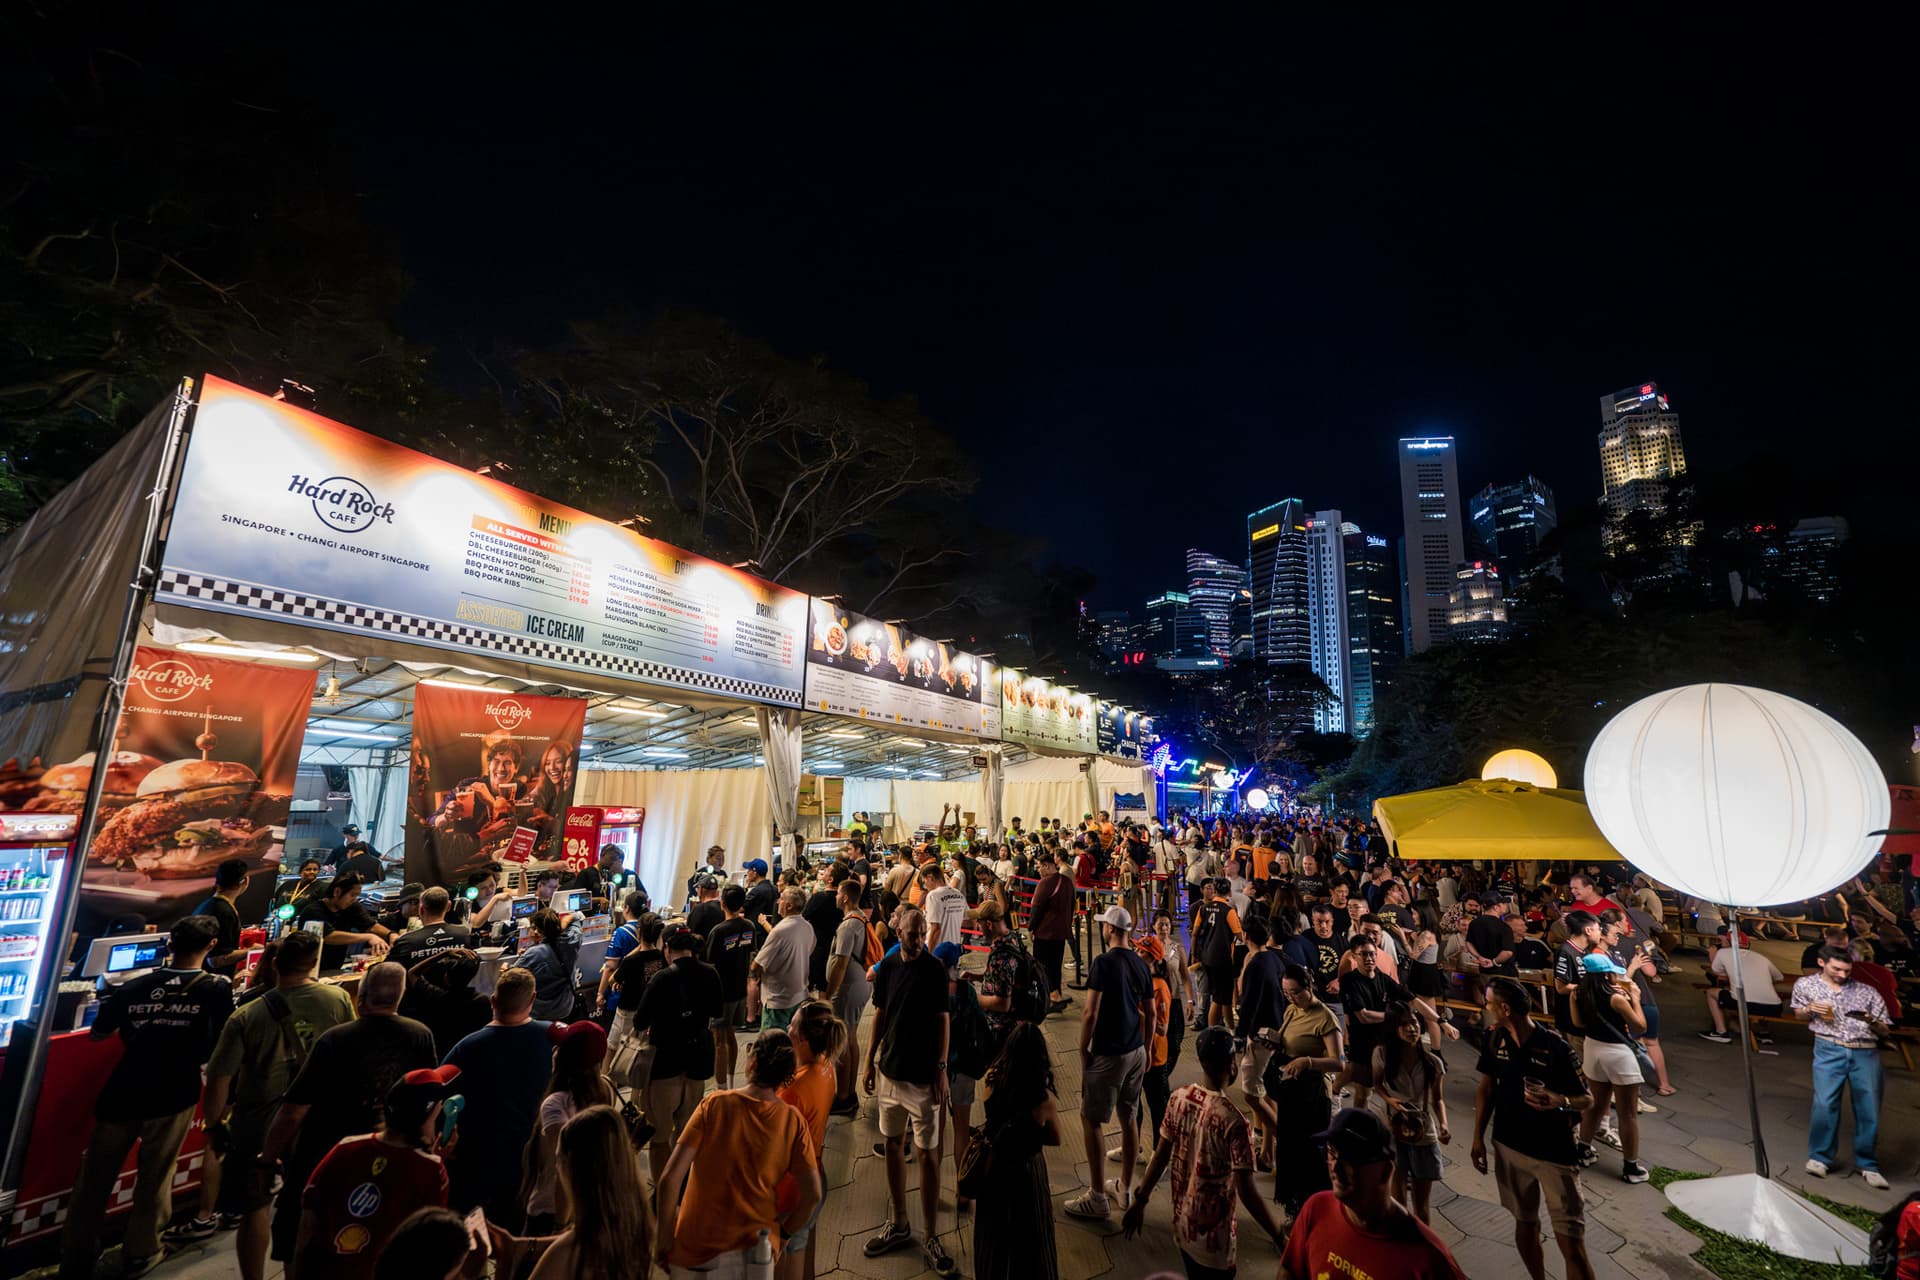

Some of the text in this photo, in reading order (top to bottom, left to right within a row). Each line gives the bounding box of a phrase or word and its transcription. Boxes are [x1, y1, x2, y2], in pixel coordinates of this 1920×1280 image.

[1640, 393, 1655, 401] UOB
[288, 475, 395, 524] Hard Rock
[330, 511, 357, 524] CAFE
[221, 514, 430, 572] SINGAPORE CHANGI AIRPORT SINGAPORE
[487, 523, 504, 534] ALL
[506, 529, 538, 544] SERVED
[470, 532, 527, 553] CHEESEBURGER
[528, 549, 550, 560] (200g)
[467, 550, 502, 564] CHICKEN
[502, 560, 519, 568] HOT
[520, 564, 536, 574] DOG
[468, 540, 484, 550] DBL
[484, 545, 540, 566] CHEESEBURGER
[542, 561, 562, 573] (400g)
[464, 568, 480, 578] BBQ
[482, 572, 503, 584] PORK
[504, 579, 520, 588] RIBS
[465, 558, 481, 568] BBQ
[483, 563, 504, 574] PORK
[505, 569, 545, 585] SANDWICH
[645, 573, 658, 581] BULL
[608, 574, 637, 586] HEINEKEN
[638, 581, 656, 592] DRAFT
[608, 582, 640, 595] HOUSEPOUR
[640, 591, 661, 601] LIQUORS
[606, 597, 622, 606] LONG
[622, 601, 643, 612] ISLAND
[644, 606, 656, 616] ICED
[657, 610, 667, 618] TEA
[606, 606, 638, 618] MARGARITA
[456, 600, 584, 642] ASSORTED ICE CREAM
[604, 612, 638, 626] SAUVIGNON
[638, 622, 656, 631] BLANC
[602, 632, 643, 646] HAAGEN-DAZS
[602, 640, 616, 648] (CUP
[620, 642, 639, 652] STICK)
[170, 670, 213, 690] Rock
[155, 686, 180, 694] CAFE
[128, 705, 243, 722] CHANGI AIRPORT SINGAPORE
[485, 704, 532, 719] Hard Rock
[578, 839, 589, 856] &
[566, 857, 588, 872] GO
[1208, 912, 1215, 926] 4
[352, 1183, 378, 1216] hp
